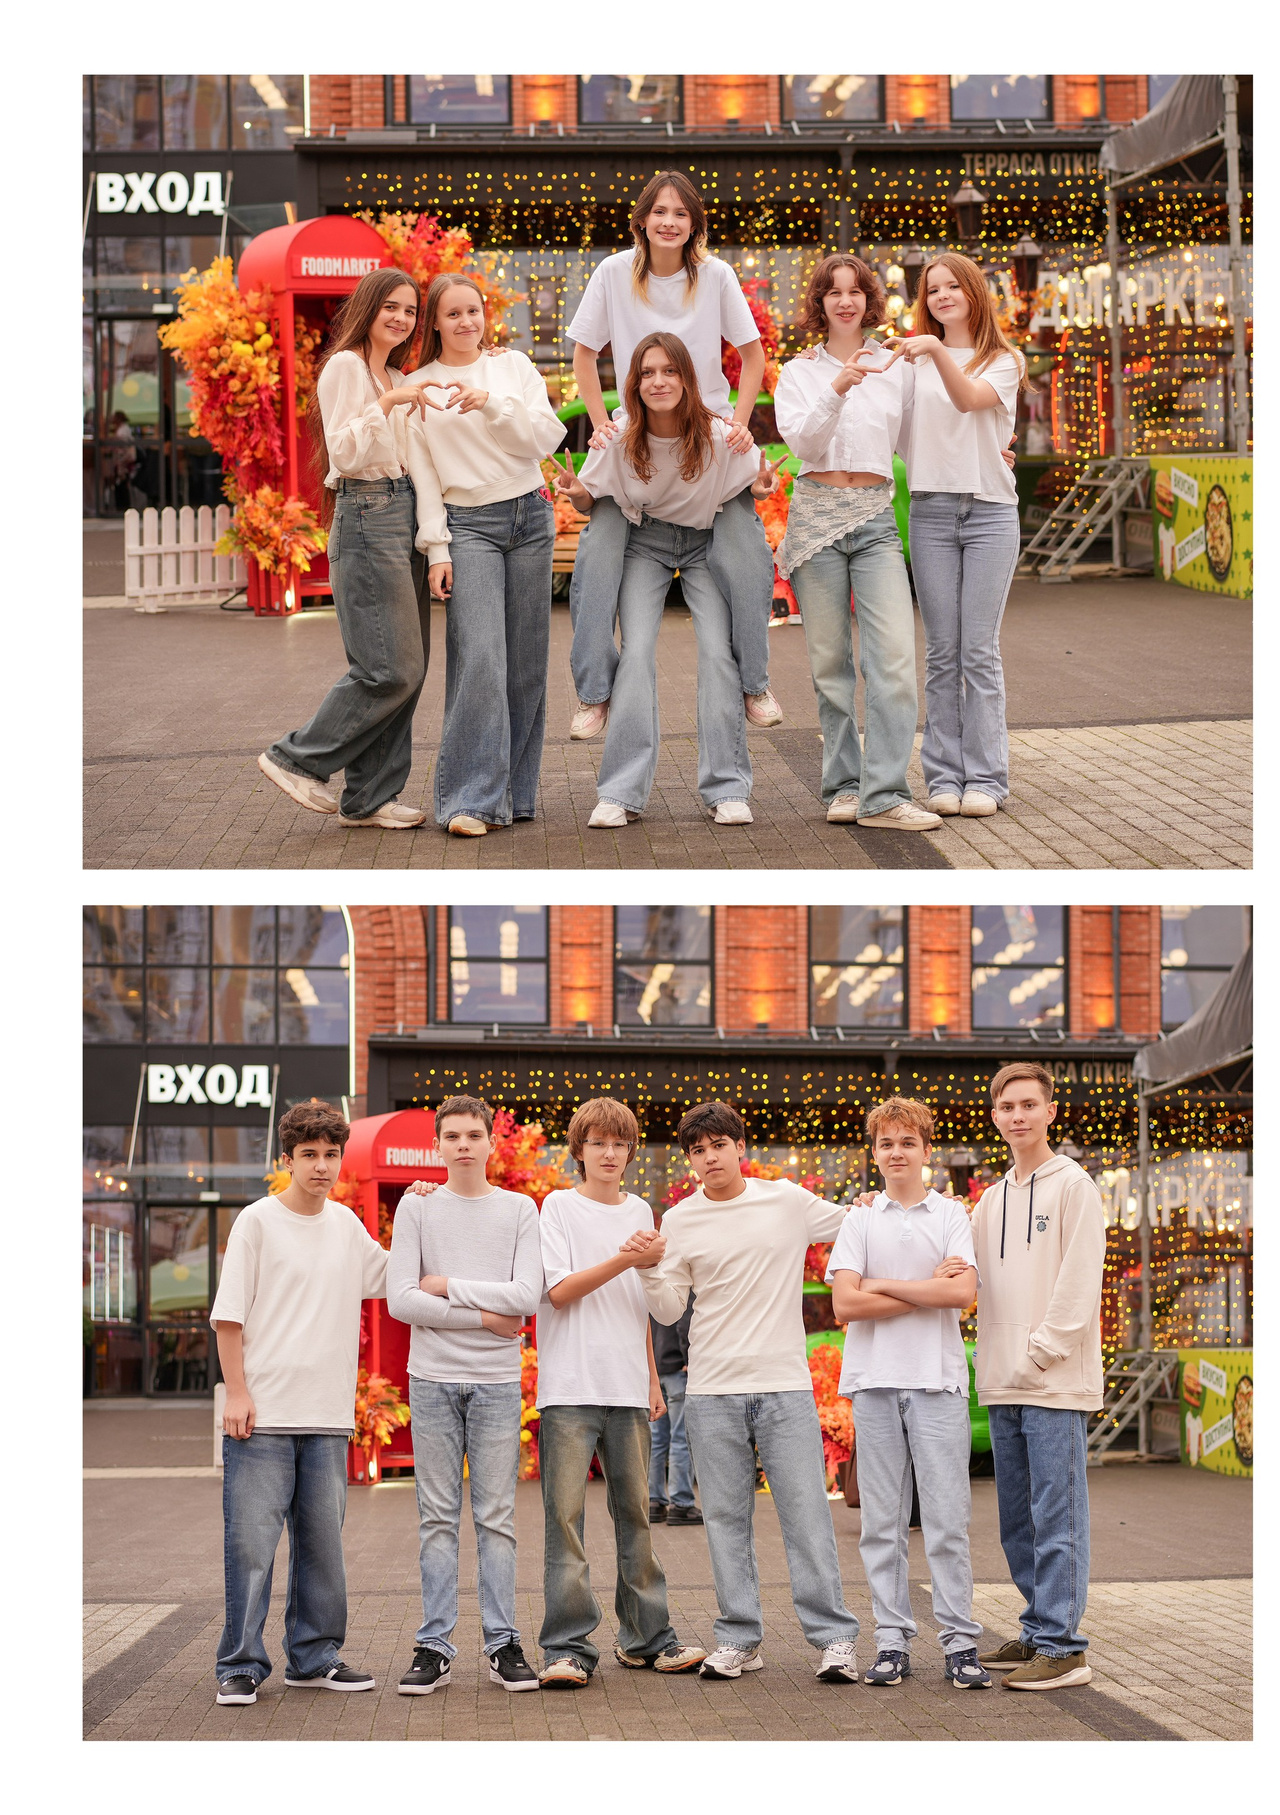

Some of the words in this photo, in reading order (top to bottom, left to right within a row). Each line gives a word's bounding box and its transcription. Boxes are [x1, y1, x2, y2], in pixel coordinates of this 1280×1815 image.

[961, 152, 1046, 177] ТЕРРАСА
[97, 171, 226, 216] ВХОД
[147, 1063, 272, 1108] ВХОД
